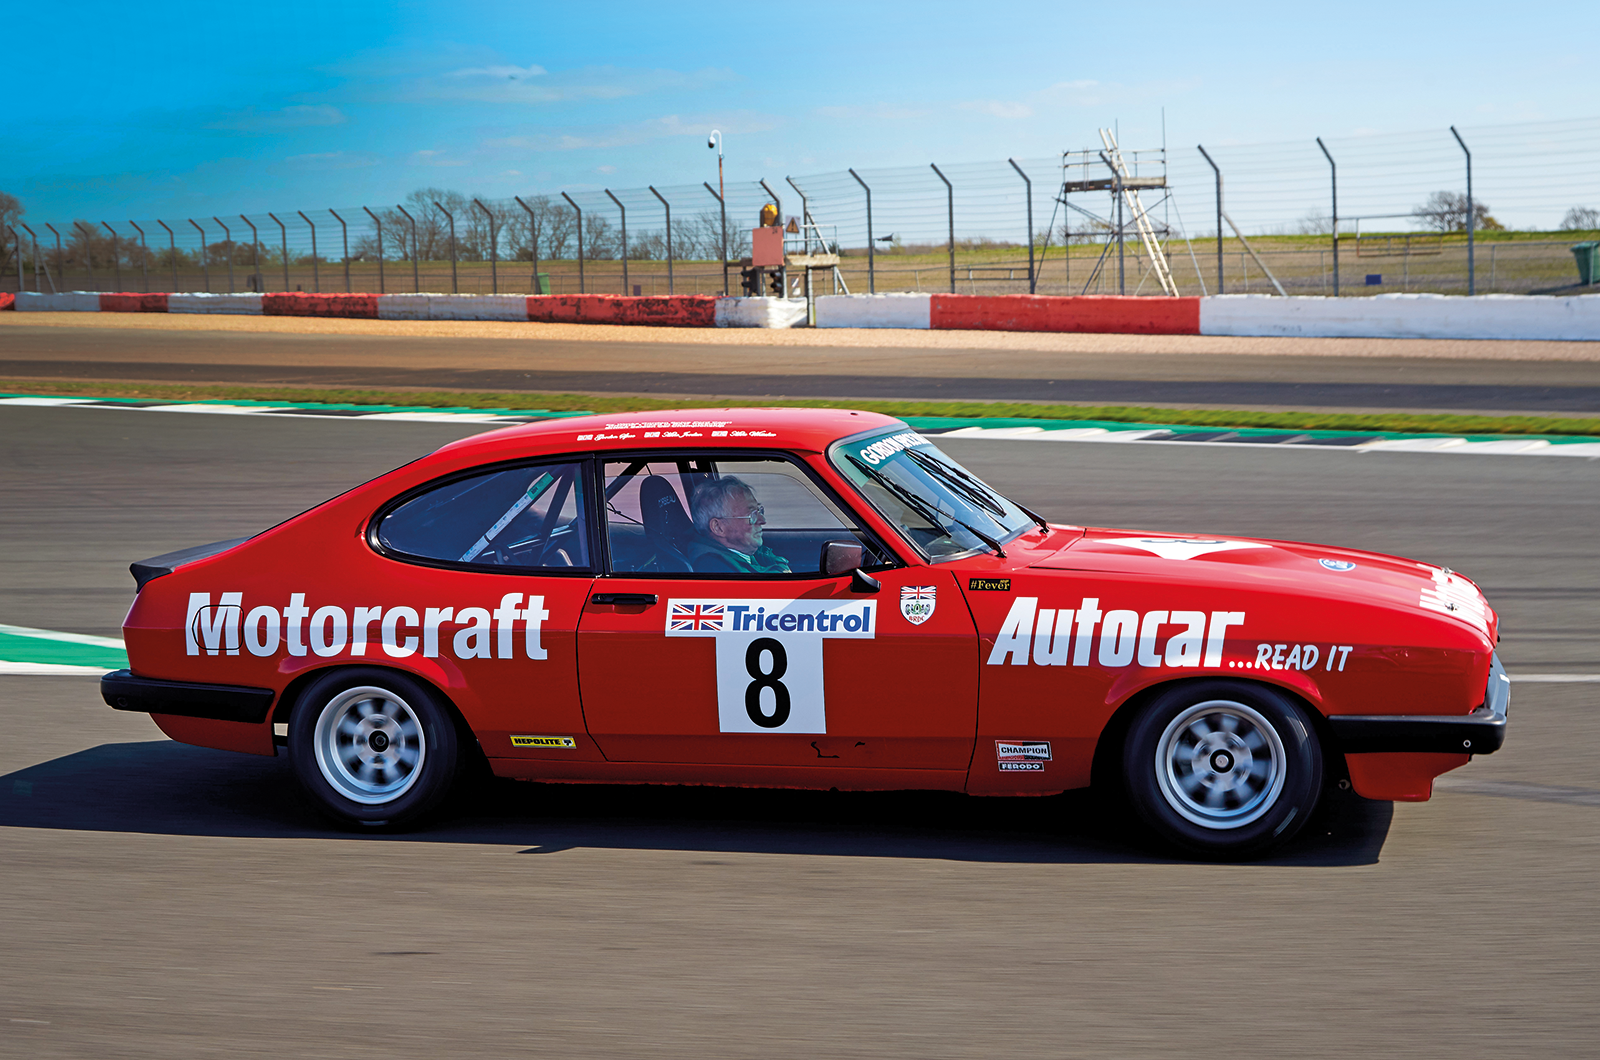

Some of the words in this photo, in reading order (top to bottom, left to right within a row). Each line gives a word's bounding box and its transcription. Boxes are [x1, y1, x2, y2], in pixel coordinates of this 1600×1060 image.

[860, 436, 904, 465] GORDON
[970, 579, 1010, 590] #Fever
[185, 592, 550, 660] Motorcraft
[727, 605, 871, 632] Tricentrol
[986, 597, 1245, 668] Autocar
[1326, 645, 1354, 672] IT
[744, 637, 791, 729] 8
[513, 737, 561, 745] HEPOLITE
[1001, 746, 1047, 754] CHAMPION
